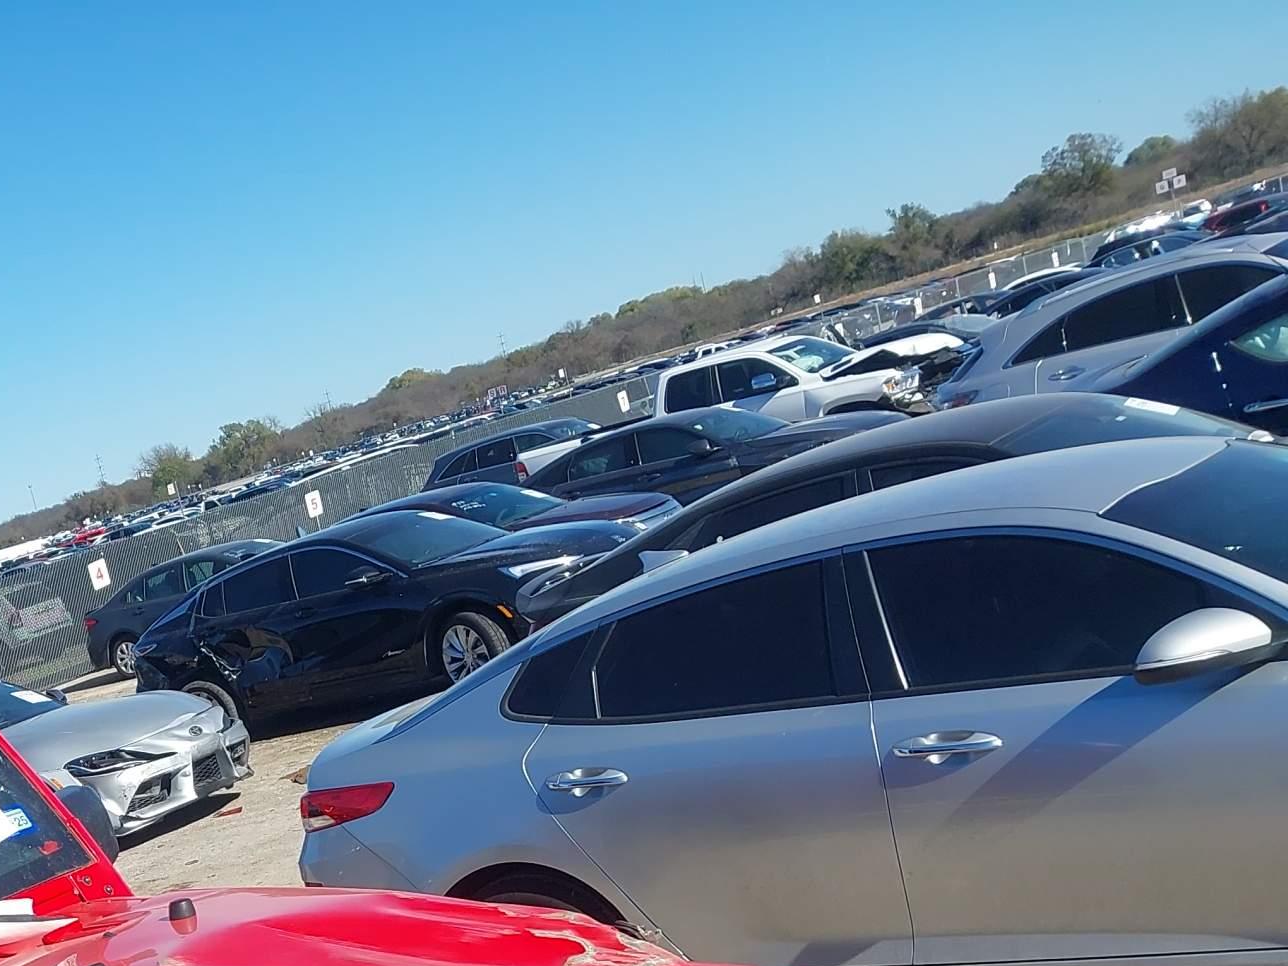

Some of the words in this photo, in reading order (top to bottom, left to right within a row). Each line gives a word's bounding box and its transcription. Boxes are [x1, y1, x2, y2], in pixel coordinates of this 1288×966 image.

[620, 396, 626, 407] 7
[310, 497, 318, 510] 5
[95, 567, 104, 581] 4
